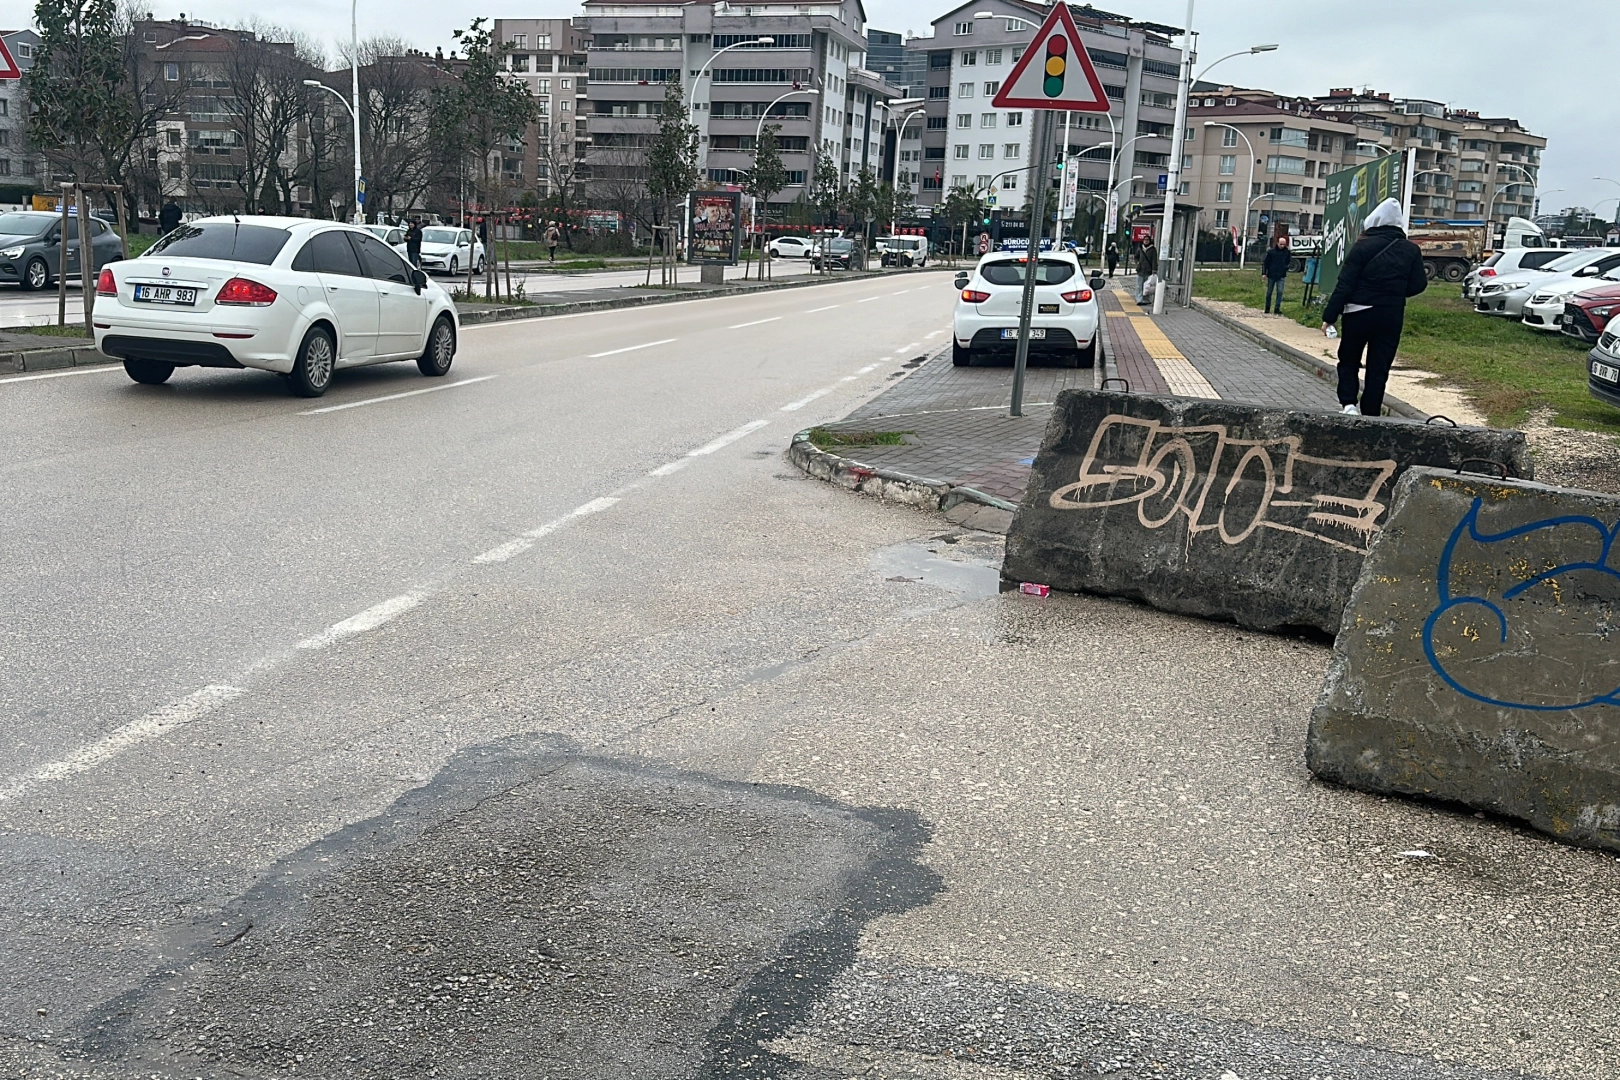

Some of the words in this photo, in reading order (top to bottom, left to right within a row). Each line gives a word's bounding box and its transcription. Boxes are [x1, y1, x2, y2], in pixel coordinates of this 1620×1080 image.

[1003, 237, 1030, 245] SÜRÜCÜ
[141, 287, 150, 298] 16
[154, 288, 171, 299] AHR
[176, 289, 194, 302] 983
[1032, 329, 1045, 337] 349
